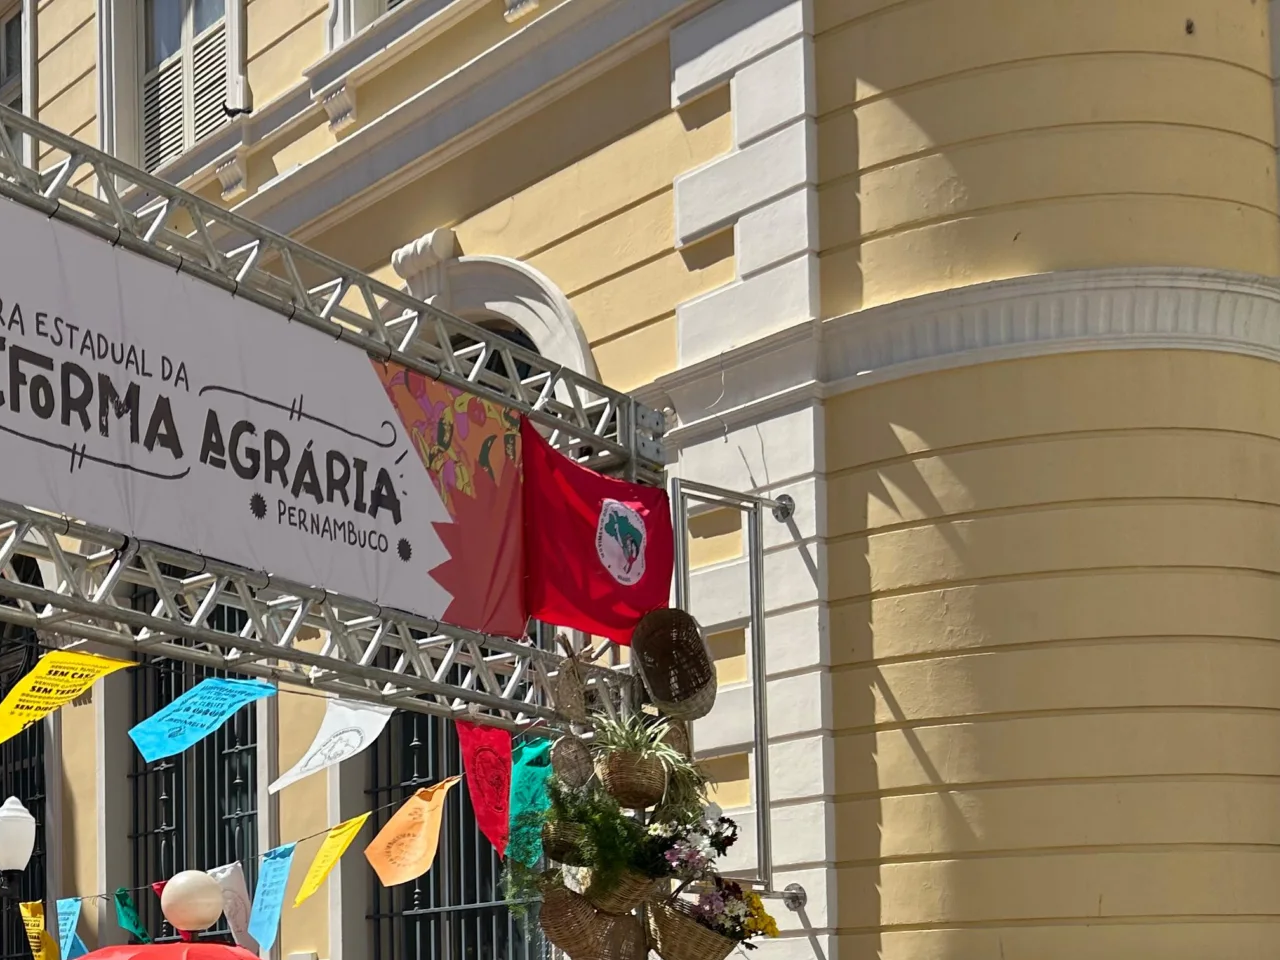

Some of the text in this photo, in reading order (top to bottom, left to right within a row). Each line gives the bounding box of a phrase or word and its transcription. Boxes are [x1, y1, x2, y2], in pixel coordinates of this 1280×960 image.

[35, 312, 153, 378] ESTADUAL
[161, 355, 190, 392] DA
[199, 408, 402, 526] AGRÁRIA
[278, 499, 389, 553] PERNAMBUCO
